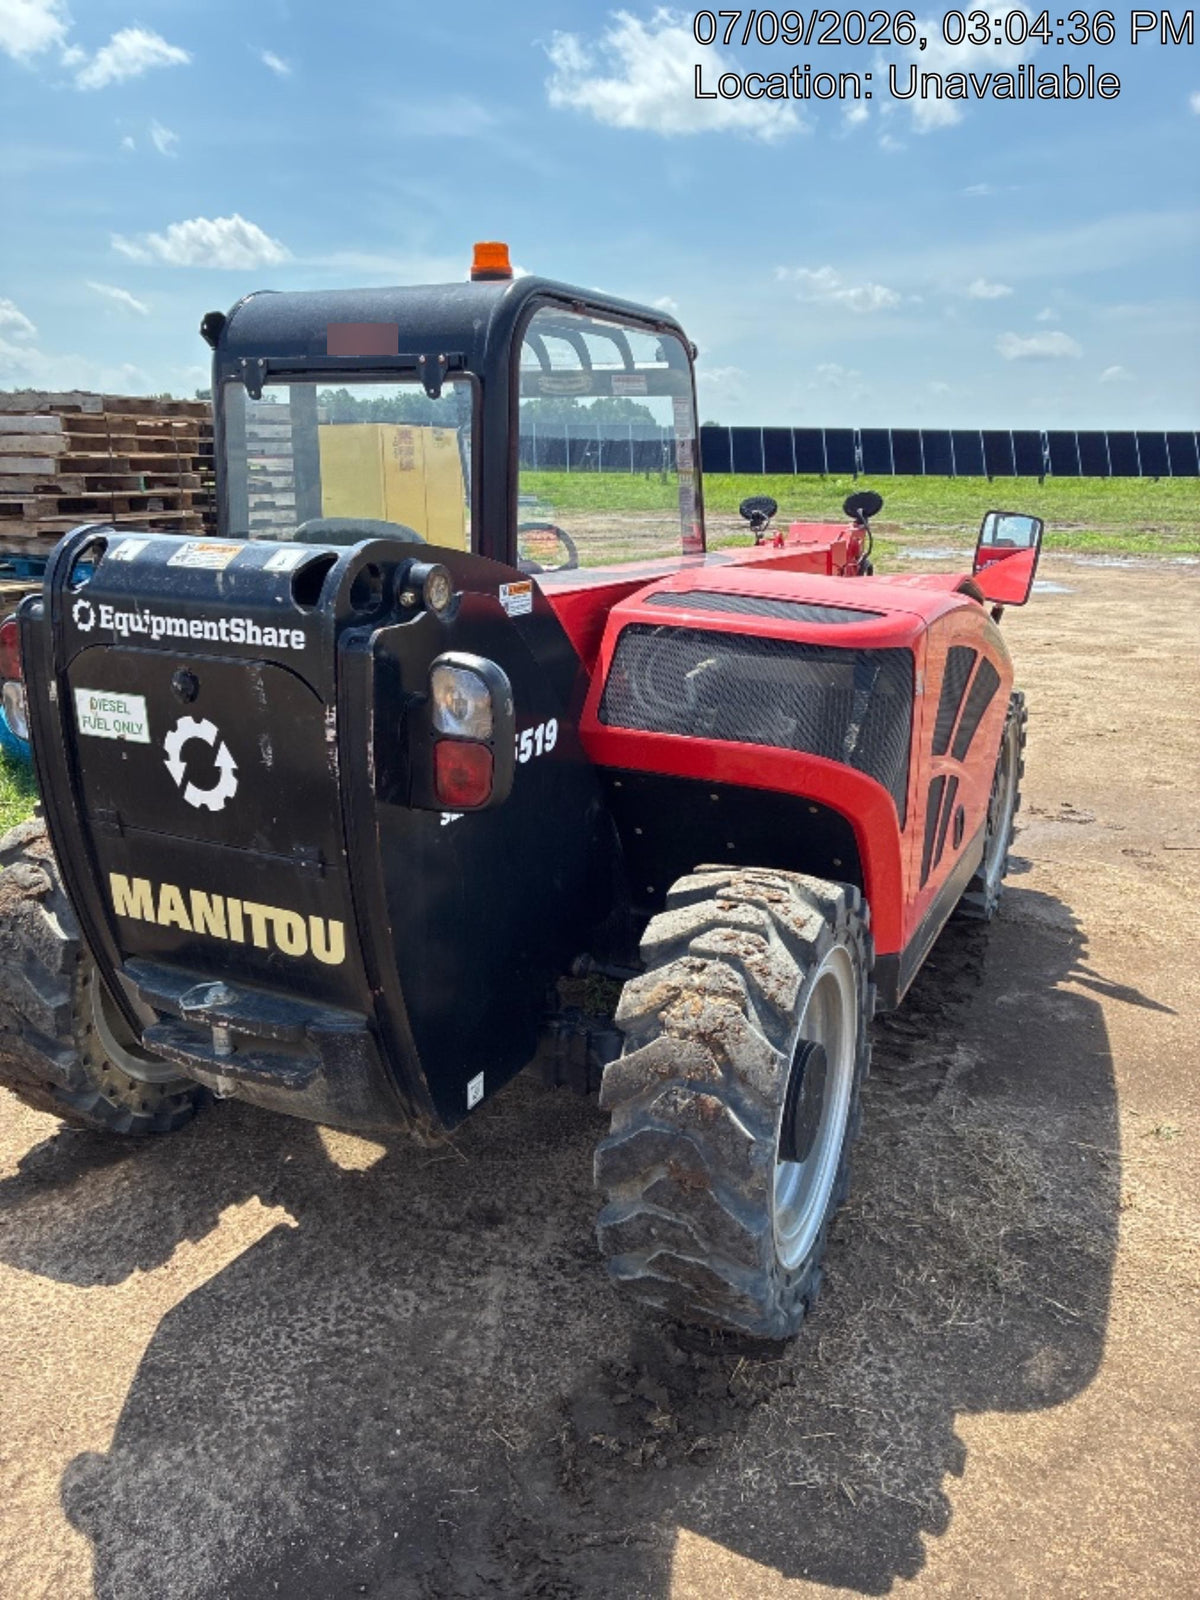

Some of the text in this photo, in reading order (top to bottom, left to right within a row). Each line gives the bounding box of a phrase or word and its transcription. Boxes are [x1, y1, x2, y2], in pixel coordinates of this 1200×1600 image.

[99, 602, 306, 650] EquipmentShare
[82, 715, 143, 735] FUEL ONLY
[89, 696, 131, 715] DIESEL
[515, 717, 559, 764] 519
[109, 872, 346, 965] MANITOU
